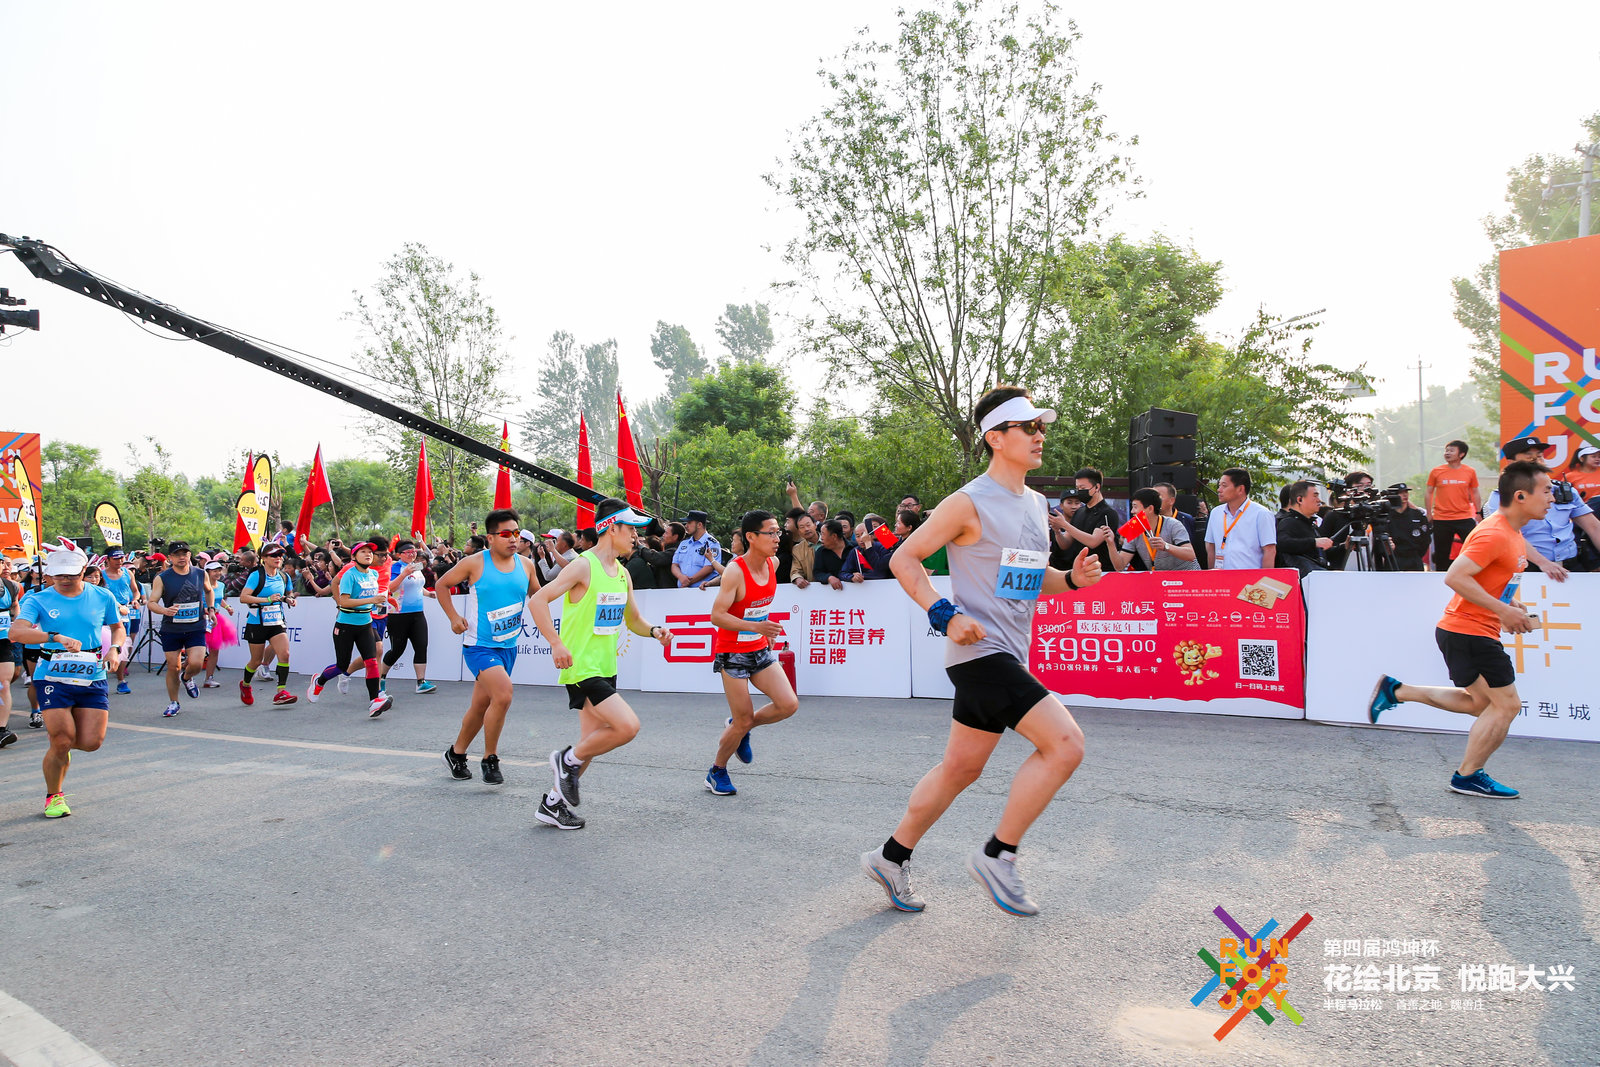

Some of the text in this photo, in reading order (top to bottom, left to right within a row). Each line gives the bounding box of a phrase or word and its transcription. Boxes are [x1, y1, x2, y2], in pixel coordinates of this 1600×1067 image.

[1534, 348, 1600, 386] RU
[1534, 389, 1600, 427] FO
[596, 516, 617, 532] SPORT
[809, 609, 866, 626] 新生代
[1079, 622, 1145, 633] 欢乐家庭年卡
[809, 628, 886, 646] 运动营养
[517, 644, 532, 655] Life
[809, 648, 847, 665] 品牌
[1037, 637, 1157, 664] ¥999.00
[50, 662, 95, 675] A1226
[1235, 682, 1285, 692] 扫一扫码上购买
